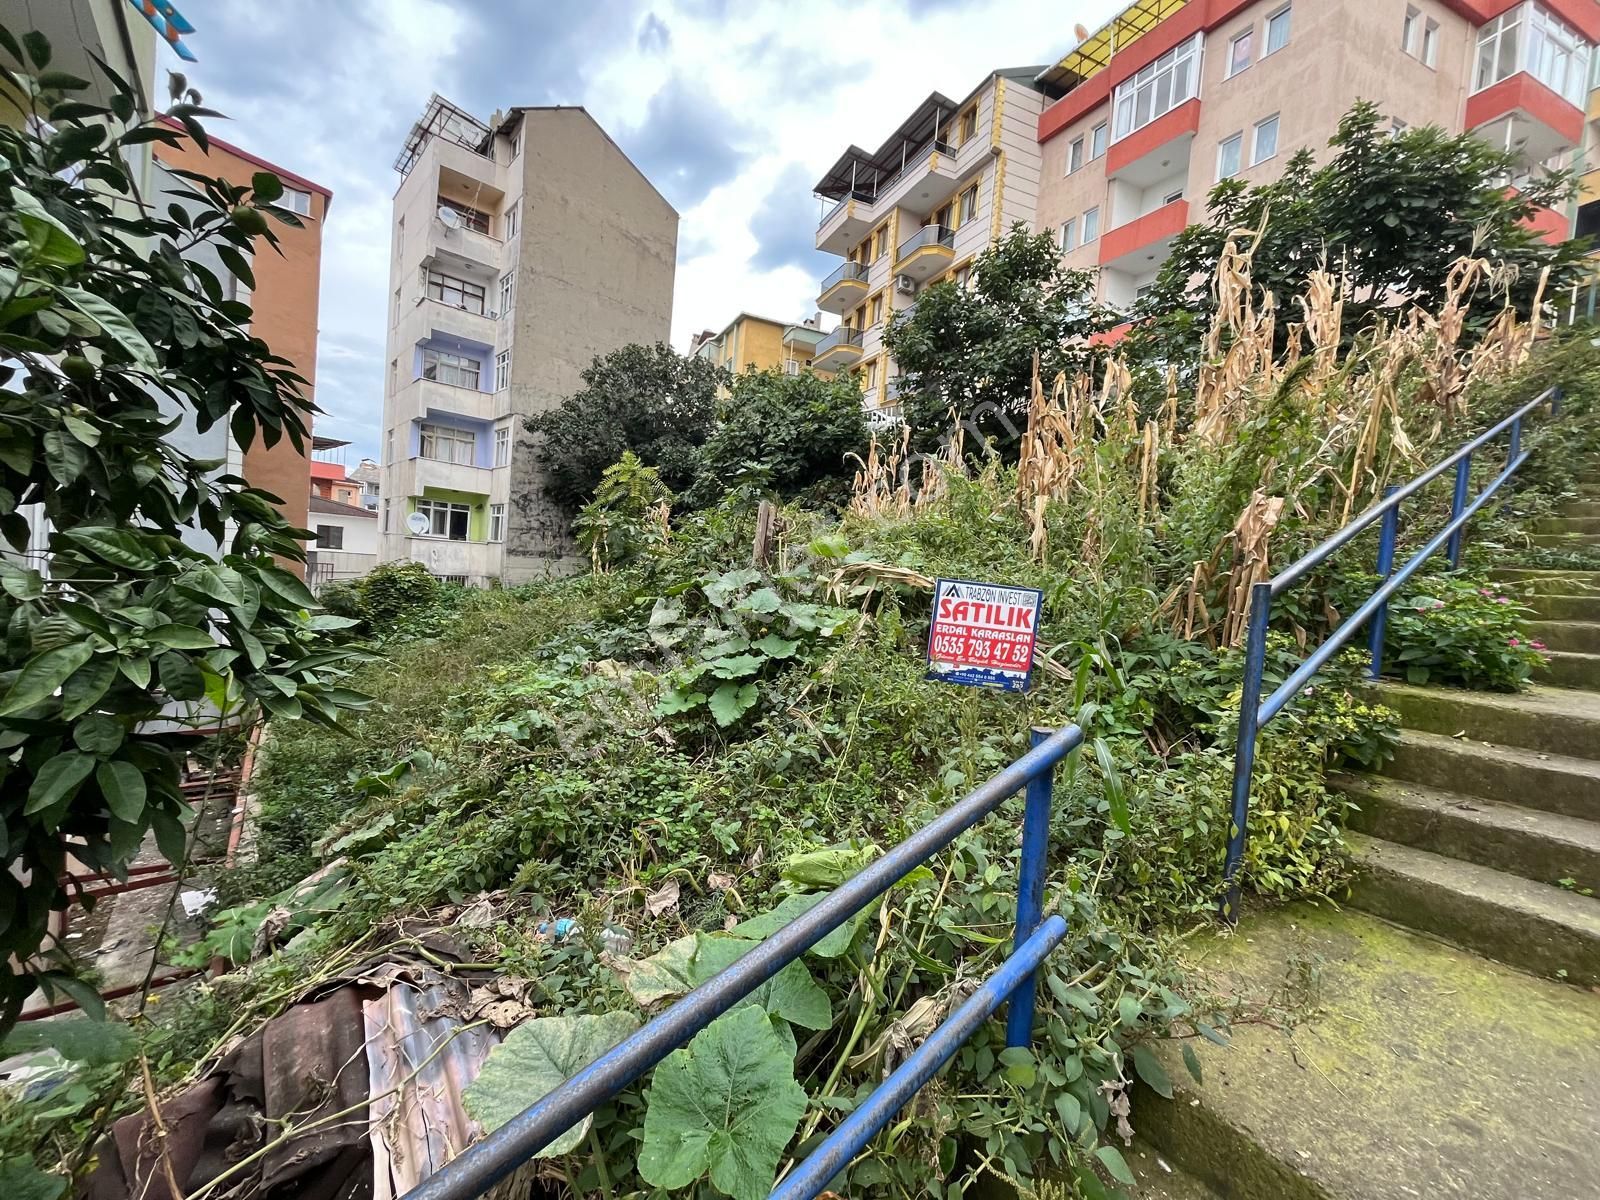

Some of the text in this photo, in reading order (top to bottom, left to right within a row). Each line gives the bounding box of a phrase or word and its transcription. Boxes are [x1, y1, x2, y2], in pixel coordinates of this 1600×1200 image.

[966, 586, 1022, 606] TRABZON INVEST
[939, 598, 1033, 629] SATILIK
[936, 624, 1031, 643] ERDAL KARAASLAN
[934, 635, 1029, 662] 0535 793 47 52
